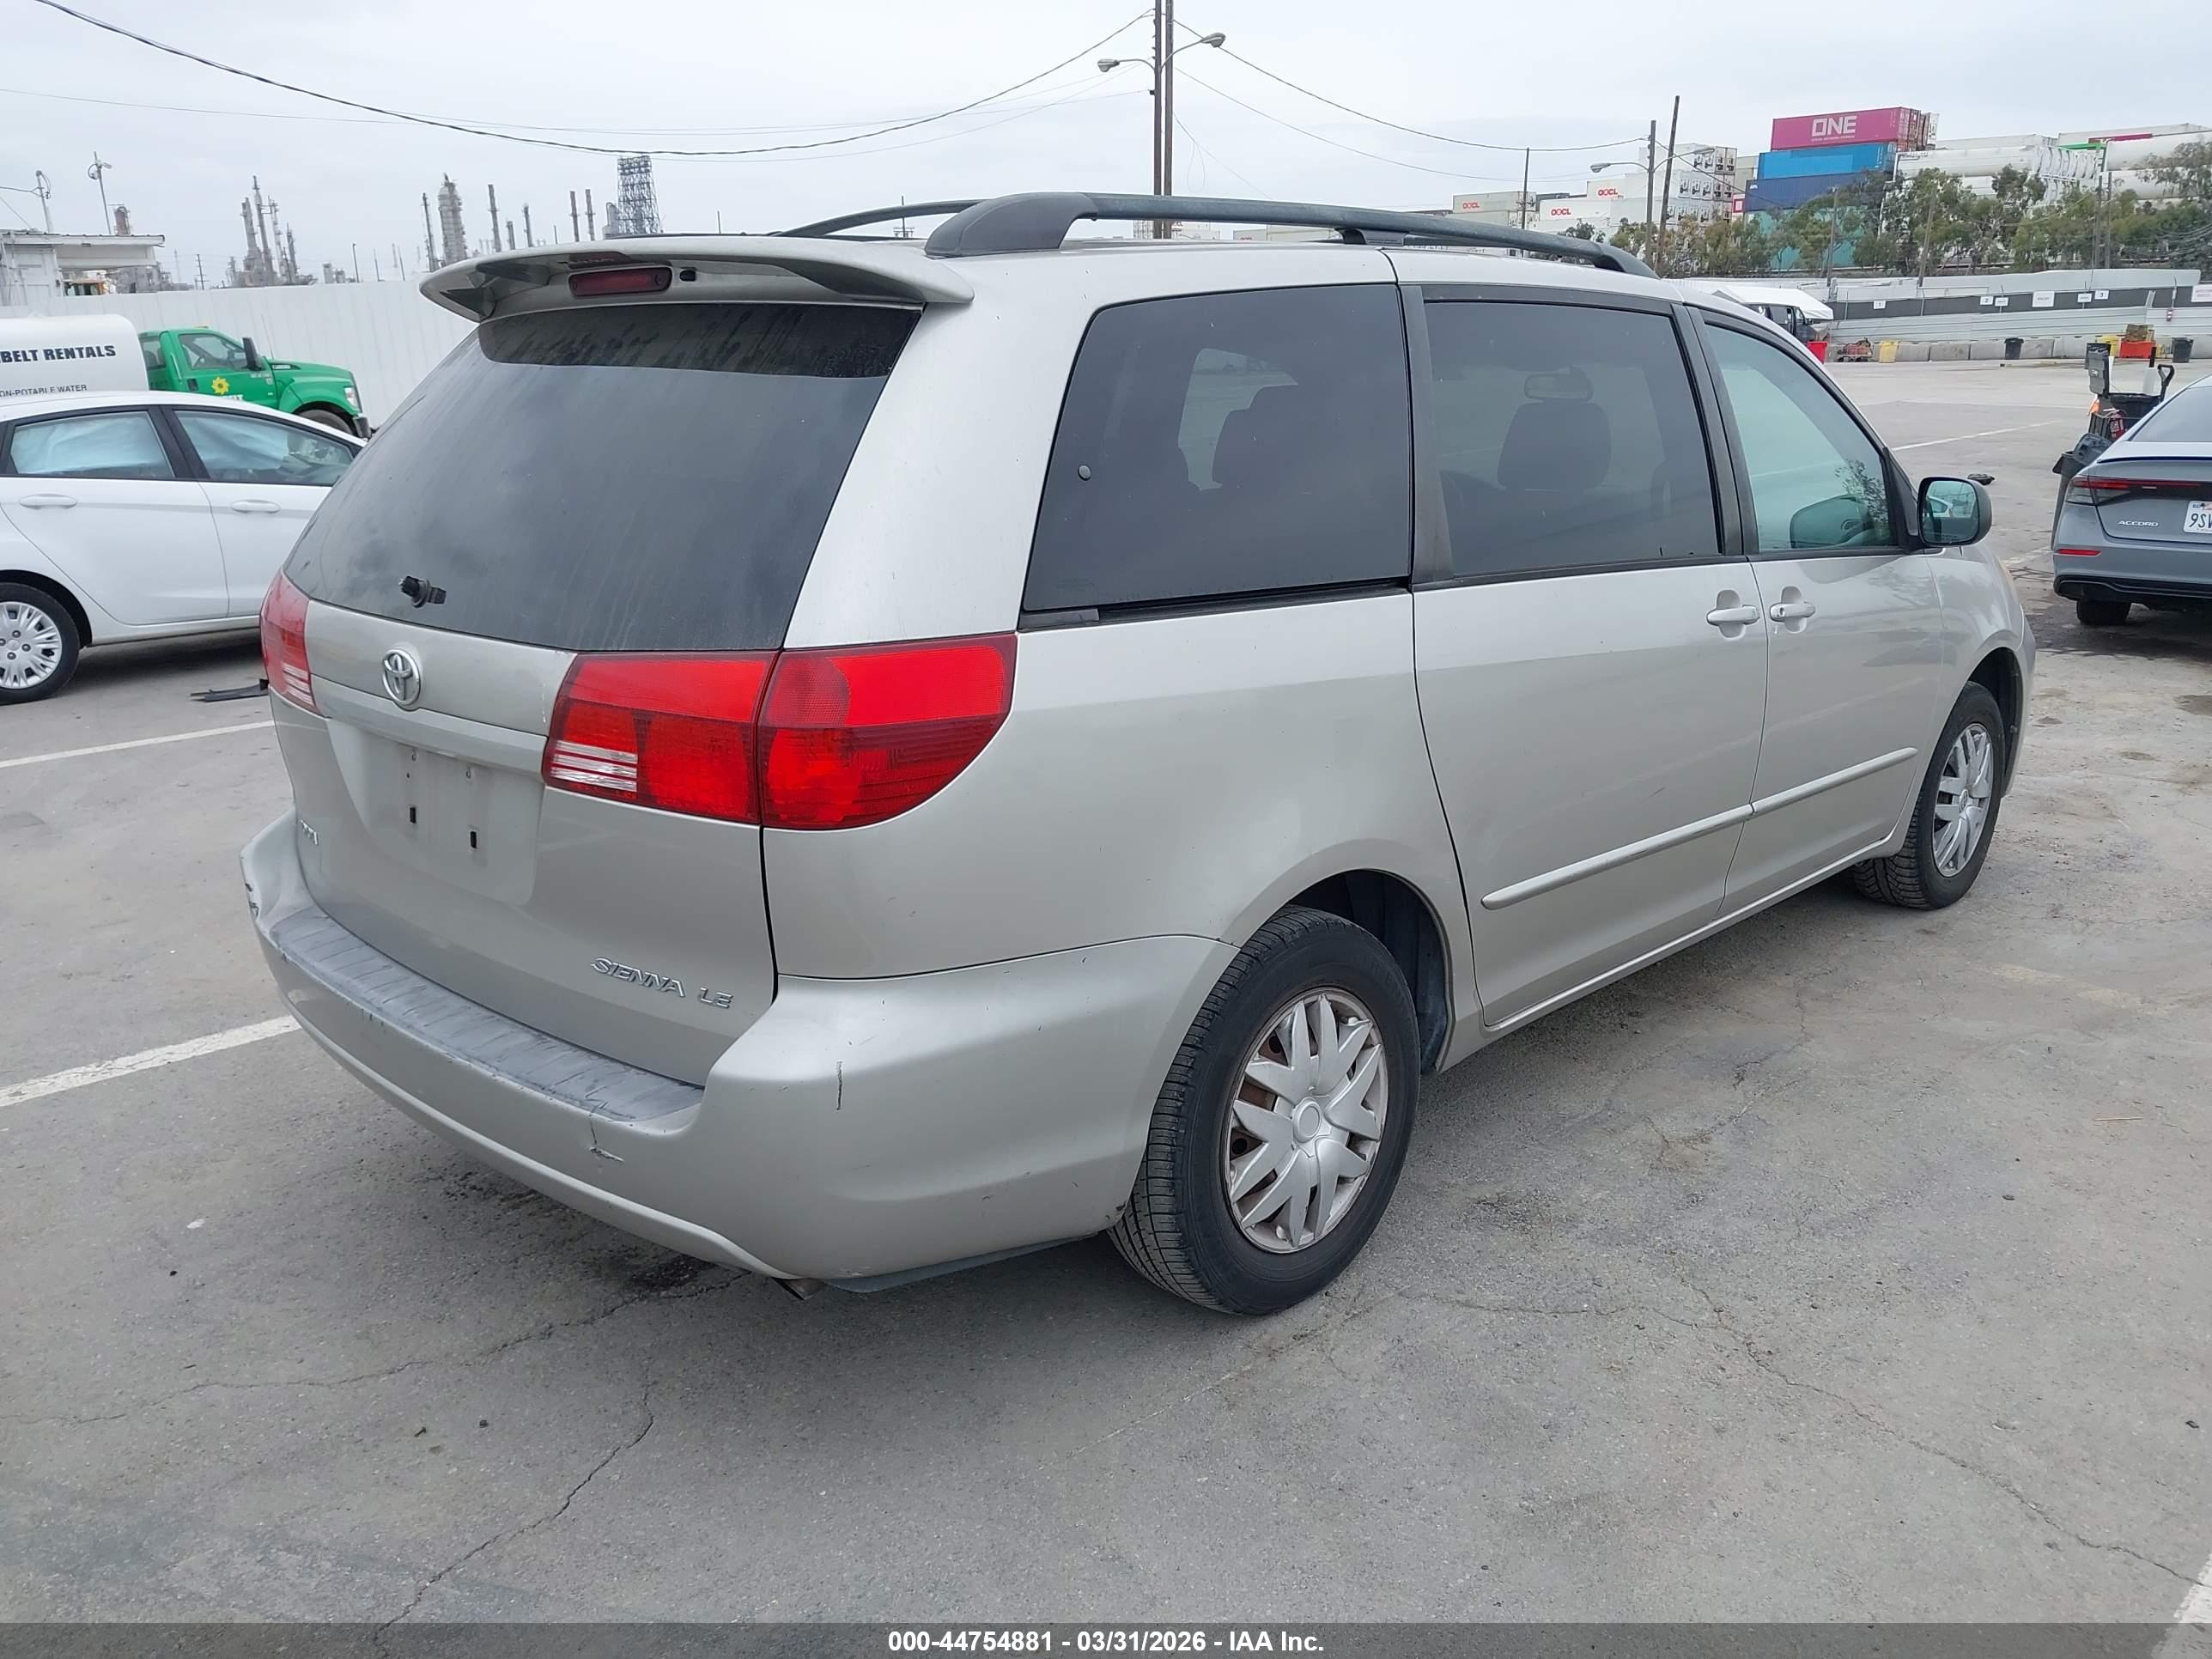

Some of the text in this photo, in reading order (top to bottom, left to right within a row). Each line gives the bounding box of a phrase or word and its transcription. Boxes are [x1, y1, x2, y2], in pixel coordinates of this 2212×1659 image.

[1811, 115, 1857, 137] ONE
[1597, 188, 1619, 197] OOCL
[0, 345, 117, 362] BELT RENTALS
[57, 384, 88, 393] WATER
[591, 957, 734, 1009] SIENNA LE
